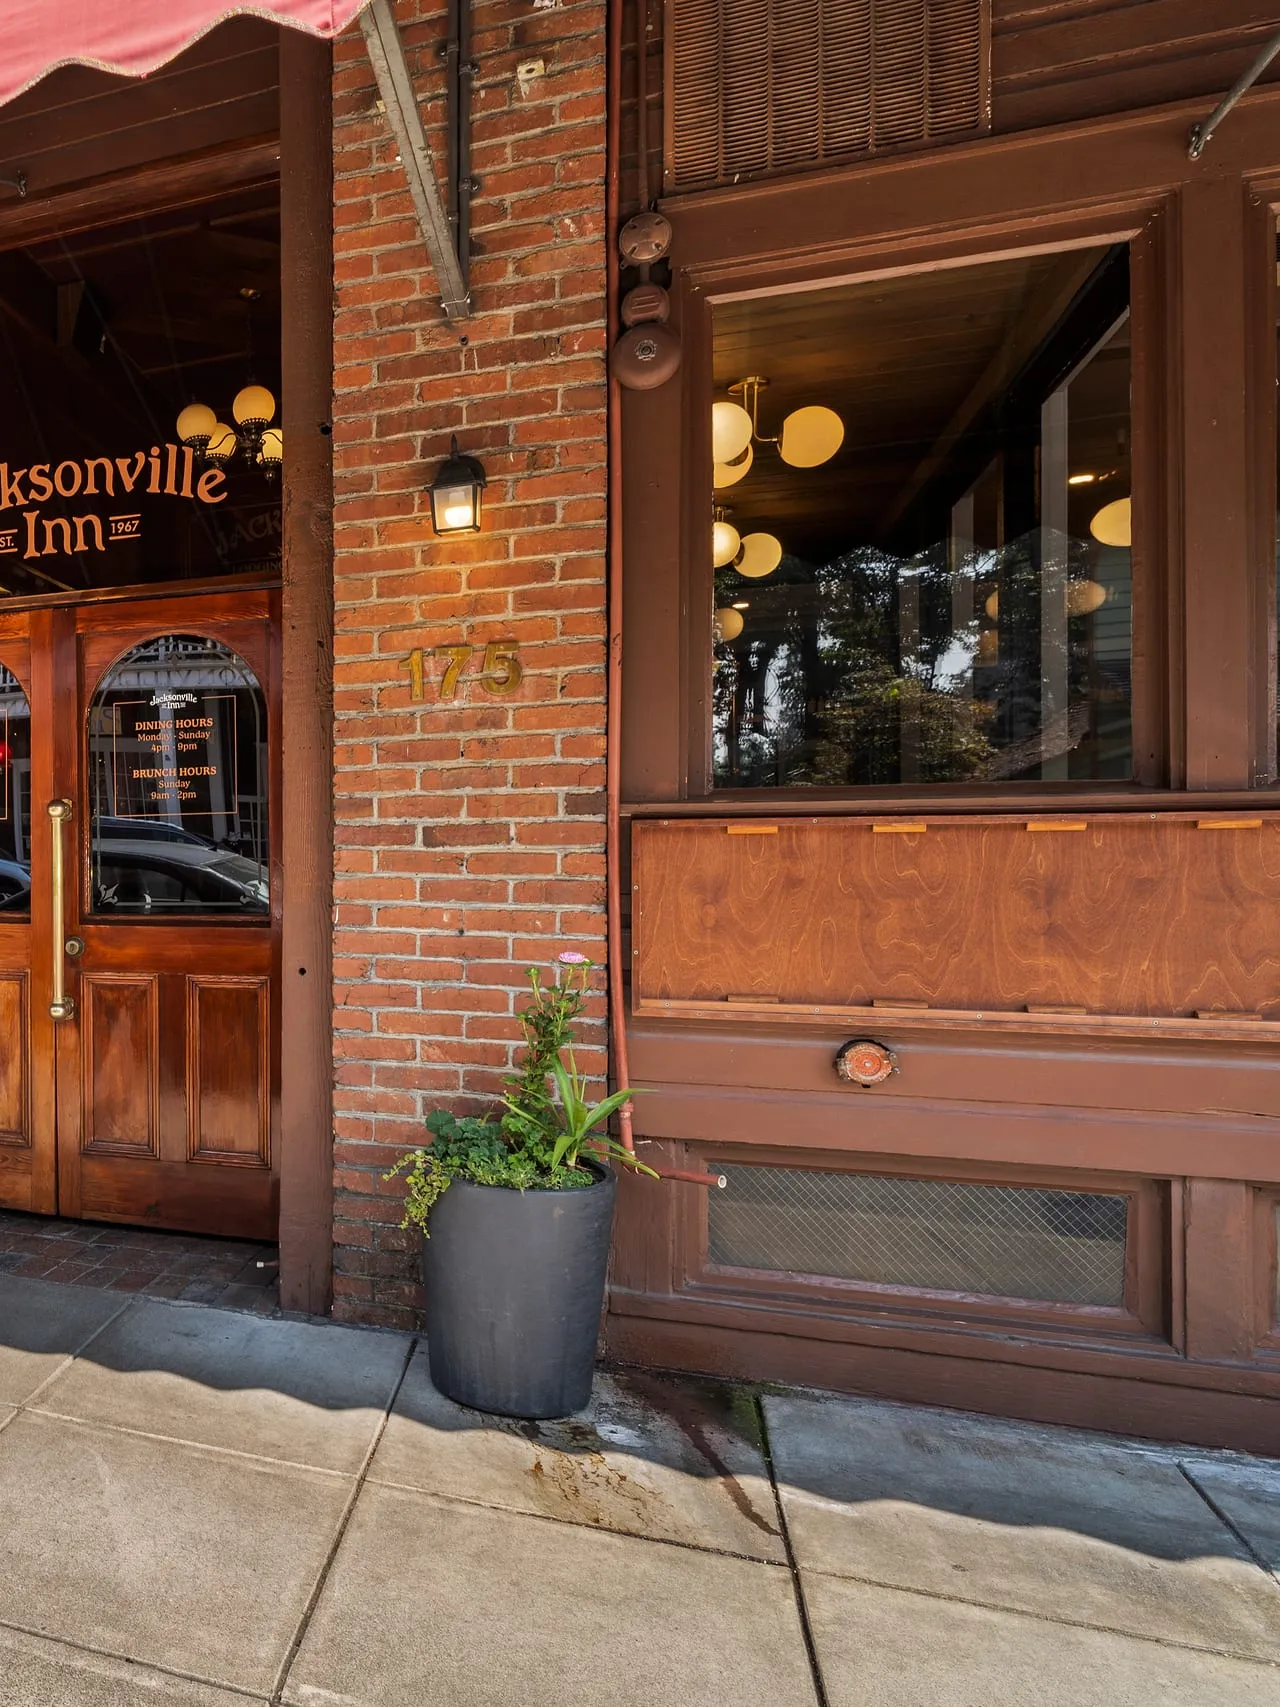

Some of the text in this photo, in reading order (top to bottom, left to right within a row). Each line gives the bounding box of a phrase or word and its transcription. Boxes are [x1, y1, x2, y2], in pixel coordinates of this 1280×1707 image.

[22, 510, 106, 560] Inn
[110, 520, 140, 534] 1967
[398, 641, 522, 700] 175
[149, 693, 198, 706] Jacksonville
[167, 701, 180, 709] Inn
[135, 717, 214, 731] DINING HOURS
[137, 733, 172, 742] Monday
[178, 730, 211, 740] Sunday
[151, 743, 170, 753] 4pm
[177, 742, 198, 752] 9pm
[132, 766, 217, 779] BRUNCH HOURS
[158, 779, 191, 789] Sunday
[150, 791, 170, 800] 9am
[177, 790, 197, 800] 2pm
